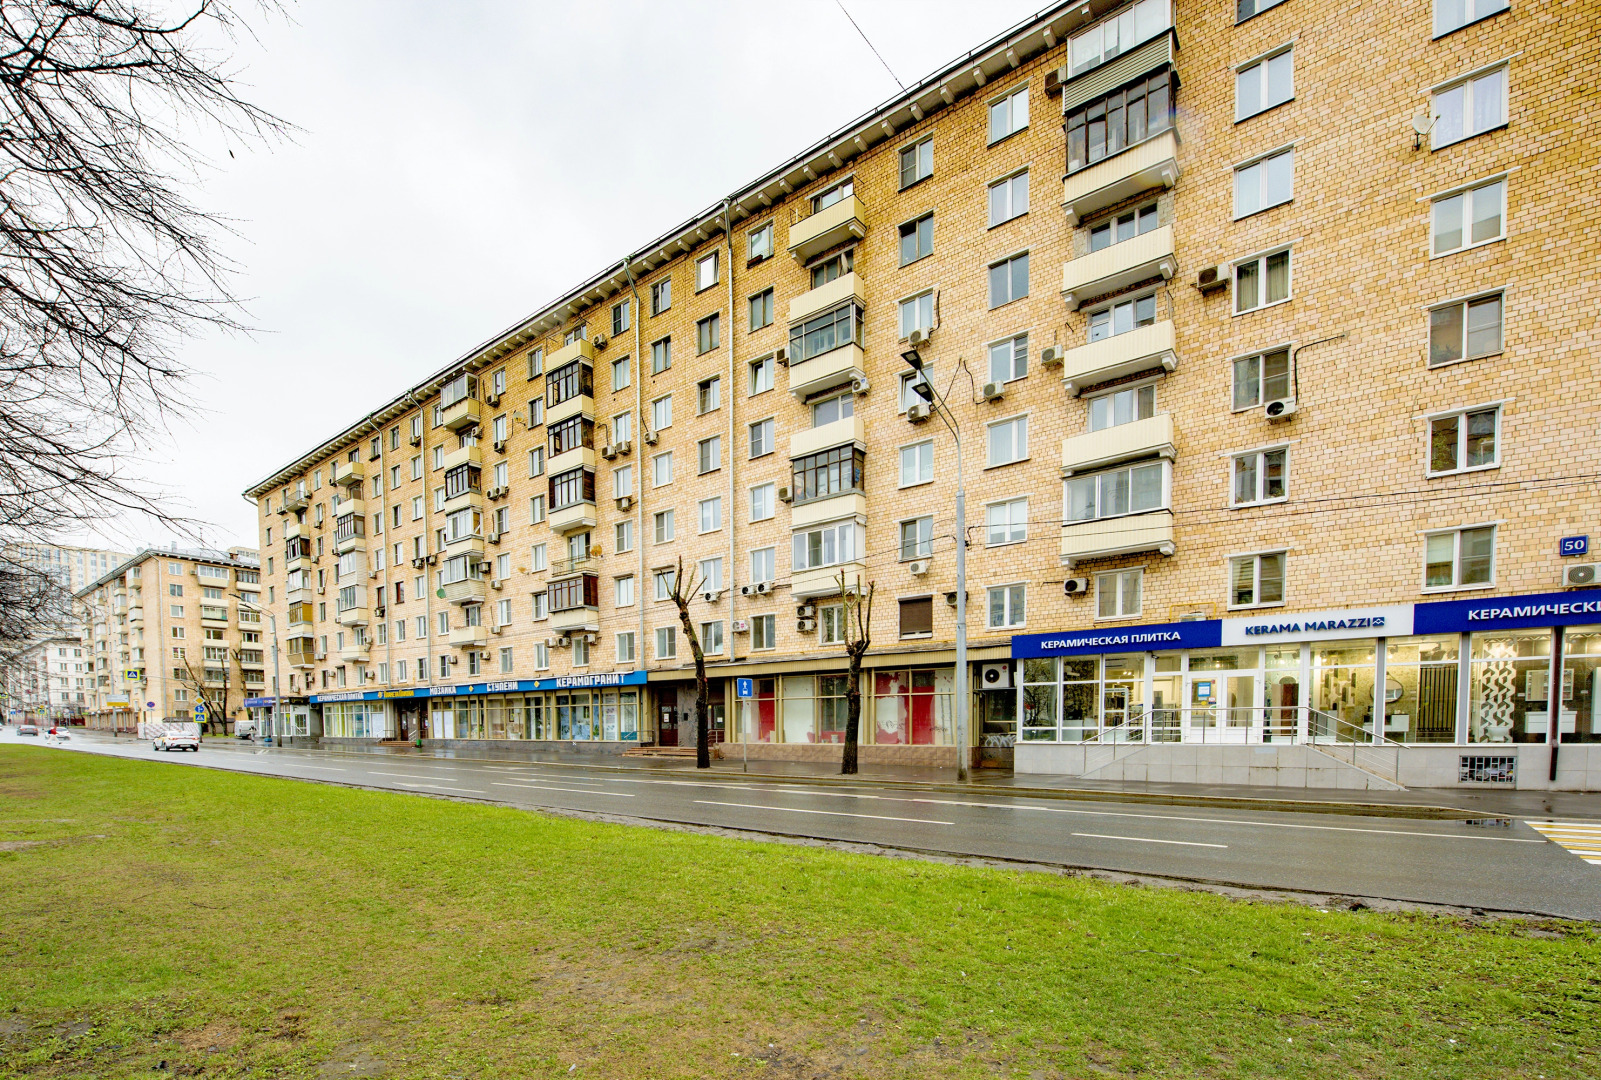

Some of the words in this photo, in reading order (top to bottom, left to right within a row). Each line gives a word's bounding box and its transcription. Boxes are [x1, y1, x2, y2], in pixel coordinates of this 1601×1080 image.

[1564, 540, 1585, 551] 50
[1245, 623, 1301, 635] KERAMA
[1304, 617, 1370, 631] MARAZZI
[1041, 635, 1128, 649] КЕРАМИЧЕСКАЯ
[1131, 631, 1181, 643] ПЛИТКА
[487, 681, 518, 692] СТУПЕНИ
[556, 674, 625, 688] КЕРАМОГРАНИТ
